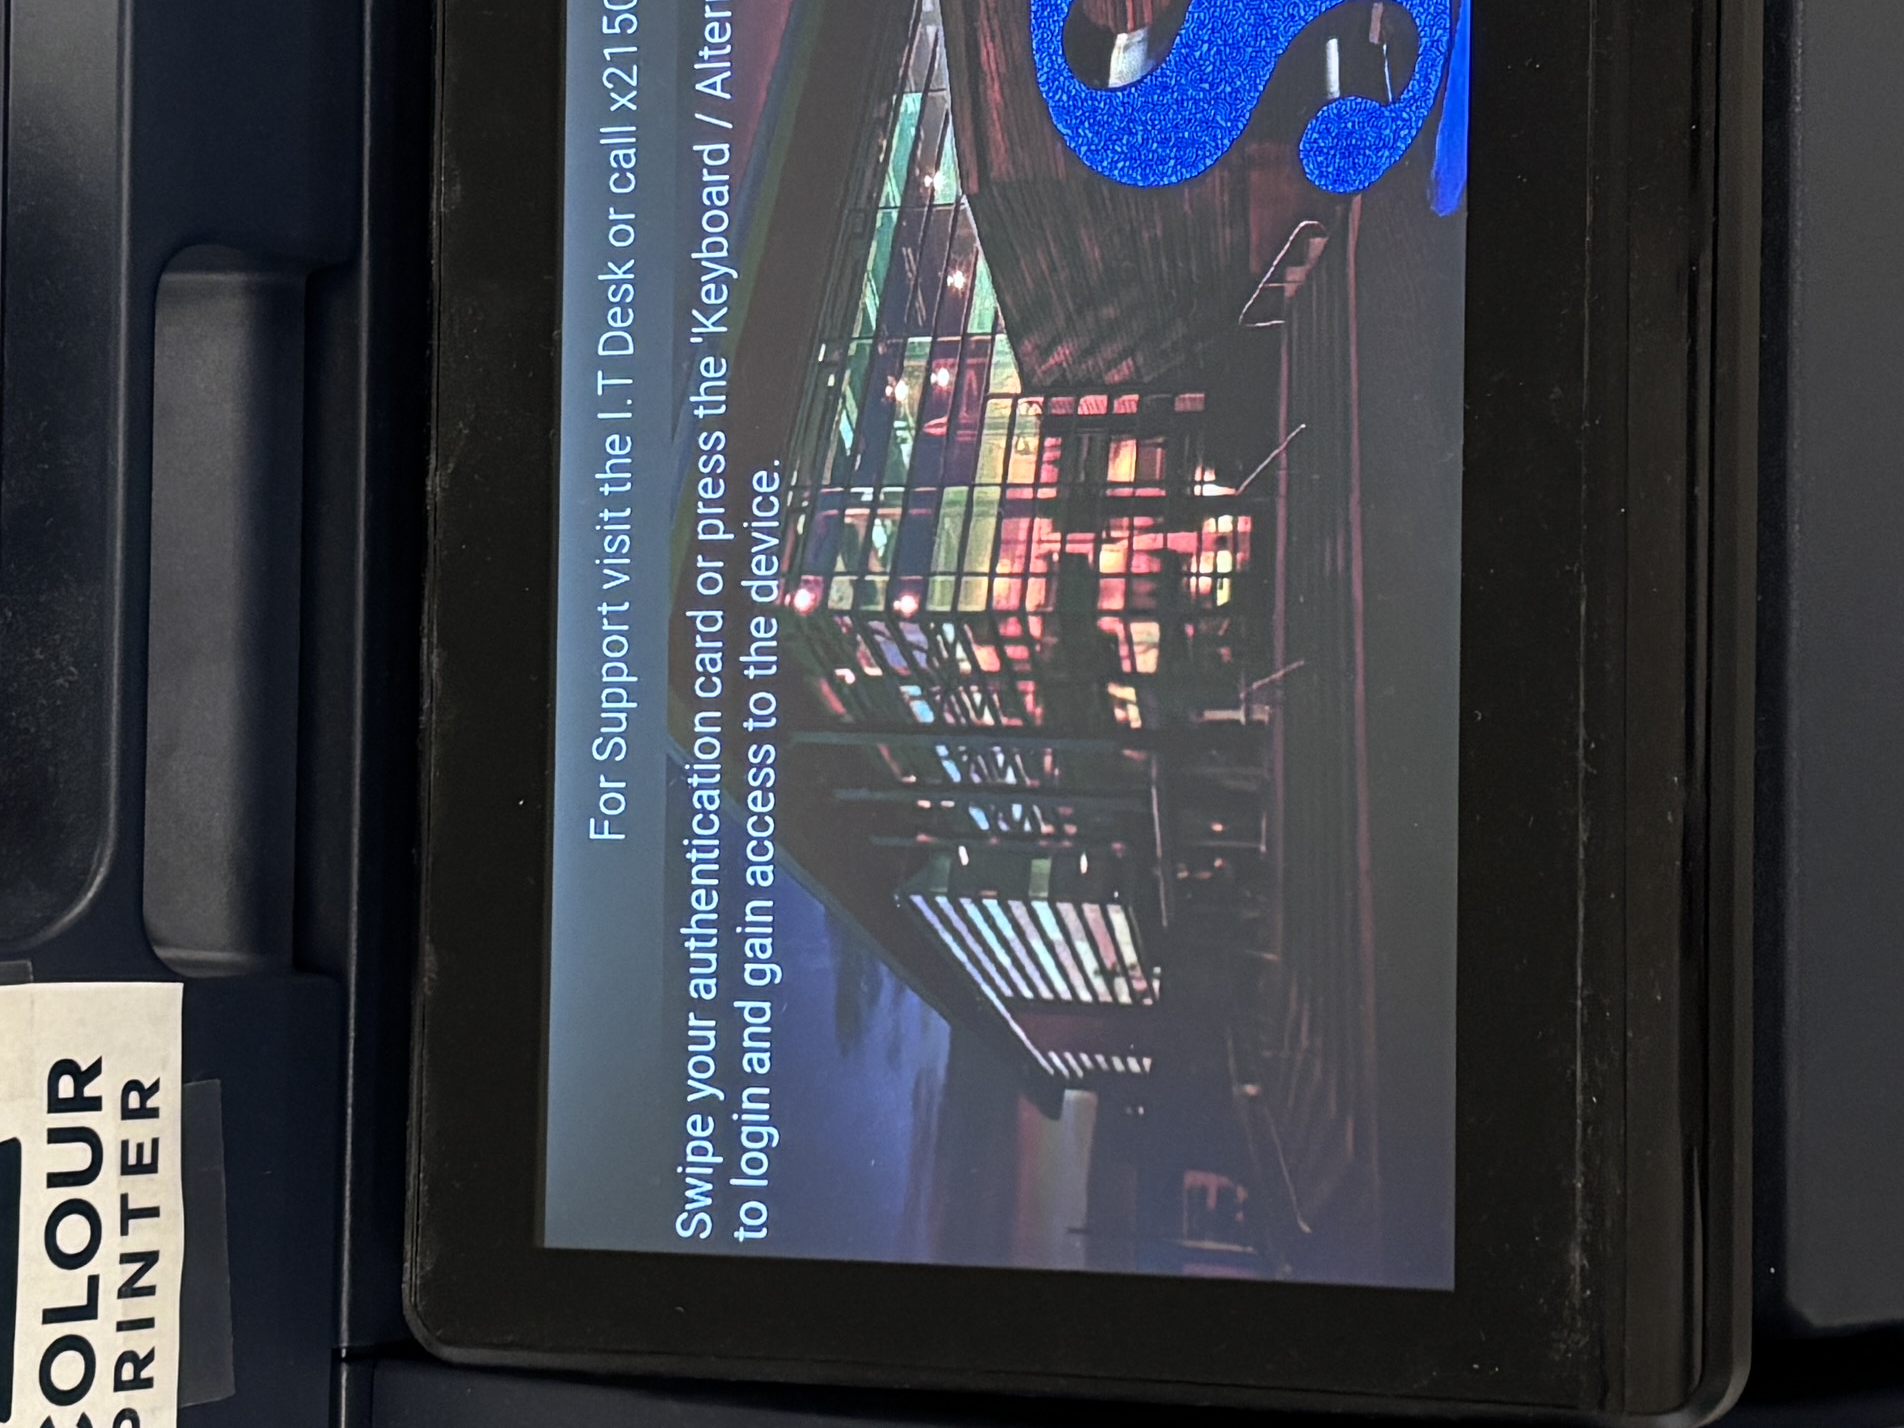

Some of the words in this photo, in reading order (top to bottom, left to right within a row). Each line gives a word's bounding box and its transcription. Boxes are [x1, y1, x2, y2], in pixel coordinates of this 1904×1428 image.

[601, 125, 638, 194] call
[694, 112, 734, 129] /
[610, 206, 637, 247] or
[691, 142, 740, 344] 'Keyboard
[598, 259, 638, 356] Desk
[599, 370, 637, 420] I.T
[690, 355, 727, 418] the
[598, 434, 635, 495] the
[694, 430, 732, 540] press
[593, 507, 632, 589] visit
[741, 457, 782, 603] device.
[697, 554, 727, 596] or
[590, 601, 638, 761] Support
[687, 611, 725, 698] card
[744, 616, 779, 679] the
[742, 691, 777, 731] to
[589, 776, 628, 841] For
[744, 744, 776, 888] access
[680, 710, 722, 1000] authentication
[739, 899, 783, 987] gain
[689, 1012, 727, 1102] your
[737, 1000, 773, 1074] and
[675, 1114, 721, 1240] Swipe
[732, 1087, 780, 1187] login
[732, 1200, 769, 1242] to
